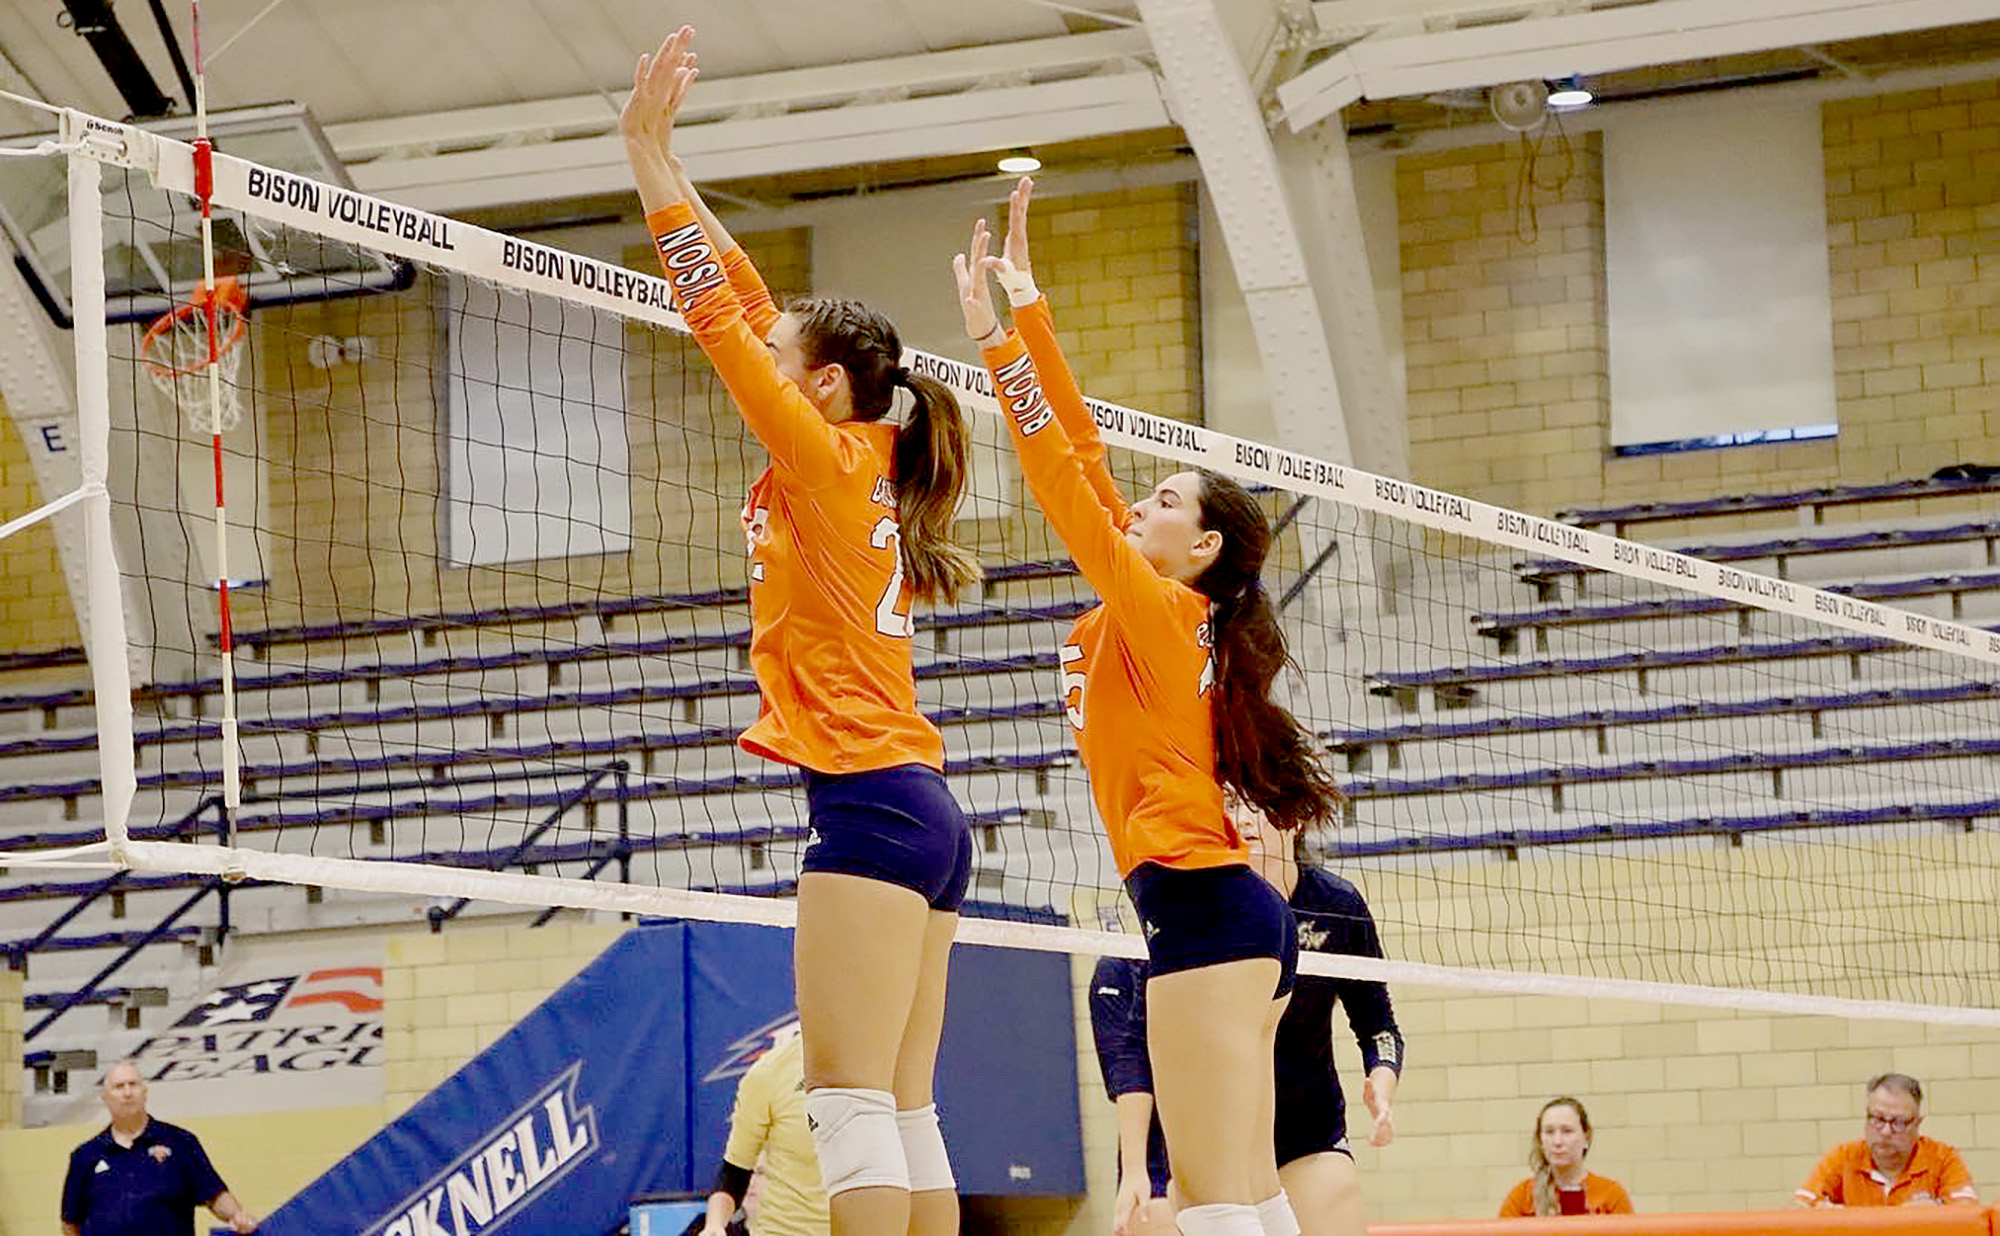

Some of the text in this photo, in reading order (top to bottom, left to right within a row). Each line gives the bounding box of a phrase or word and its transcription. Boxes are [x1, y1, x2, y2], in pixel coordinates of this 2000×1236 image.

[248, 167, 455, 251] BISON VOLLEYBALL
[502, 239, 679, 313] BISON VOLLEYBALL
[656, 221, 726, 312] ISON
[994, 351, 1054, 437] BISON
[41, 425, 67, 452] E
[1085, 402, 1208, 453] ISON VOLLEYBALL
[1235, 443, 1345, 490] BISON VOLLEYBALL
[1374, 478, 1408, 505] BISON
[1497, 511, 1529, 538] BISON
